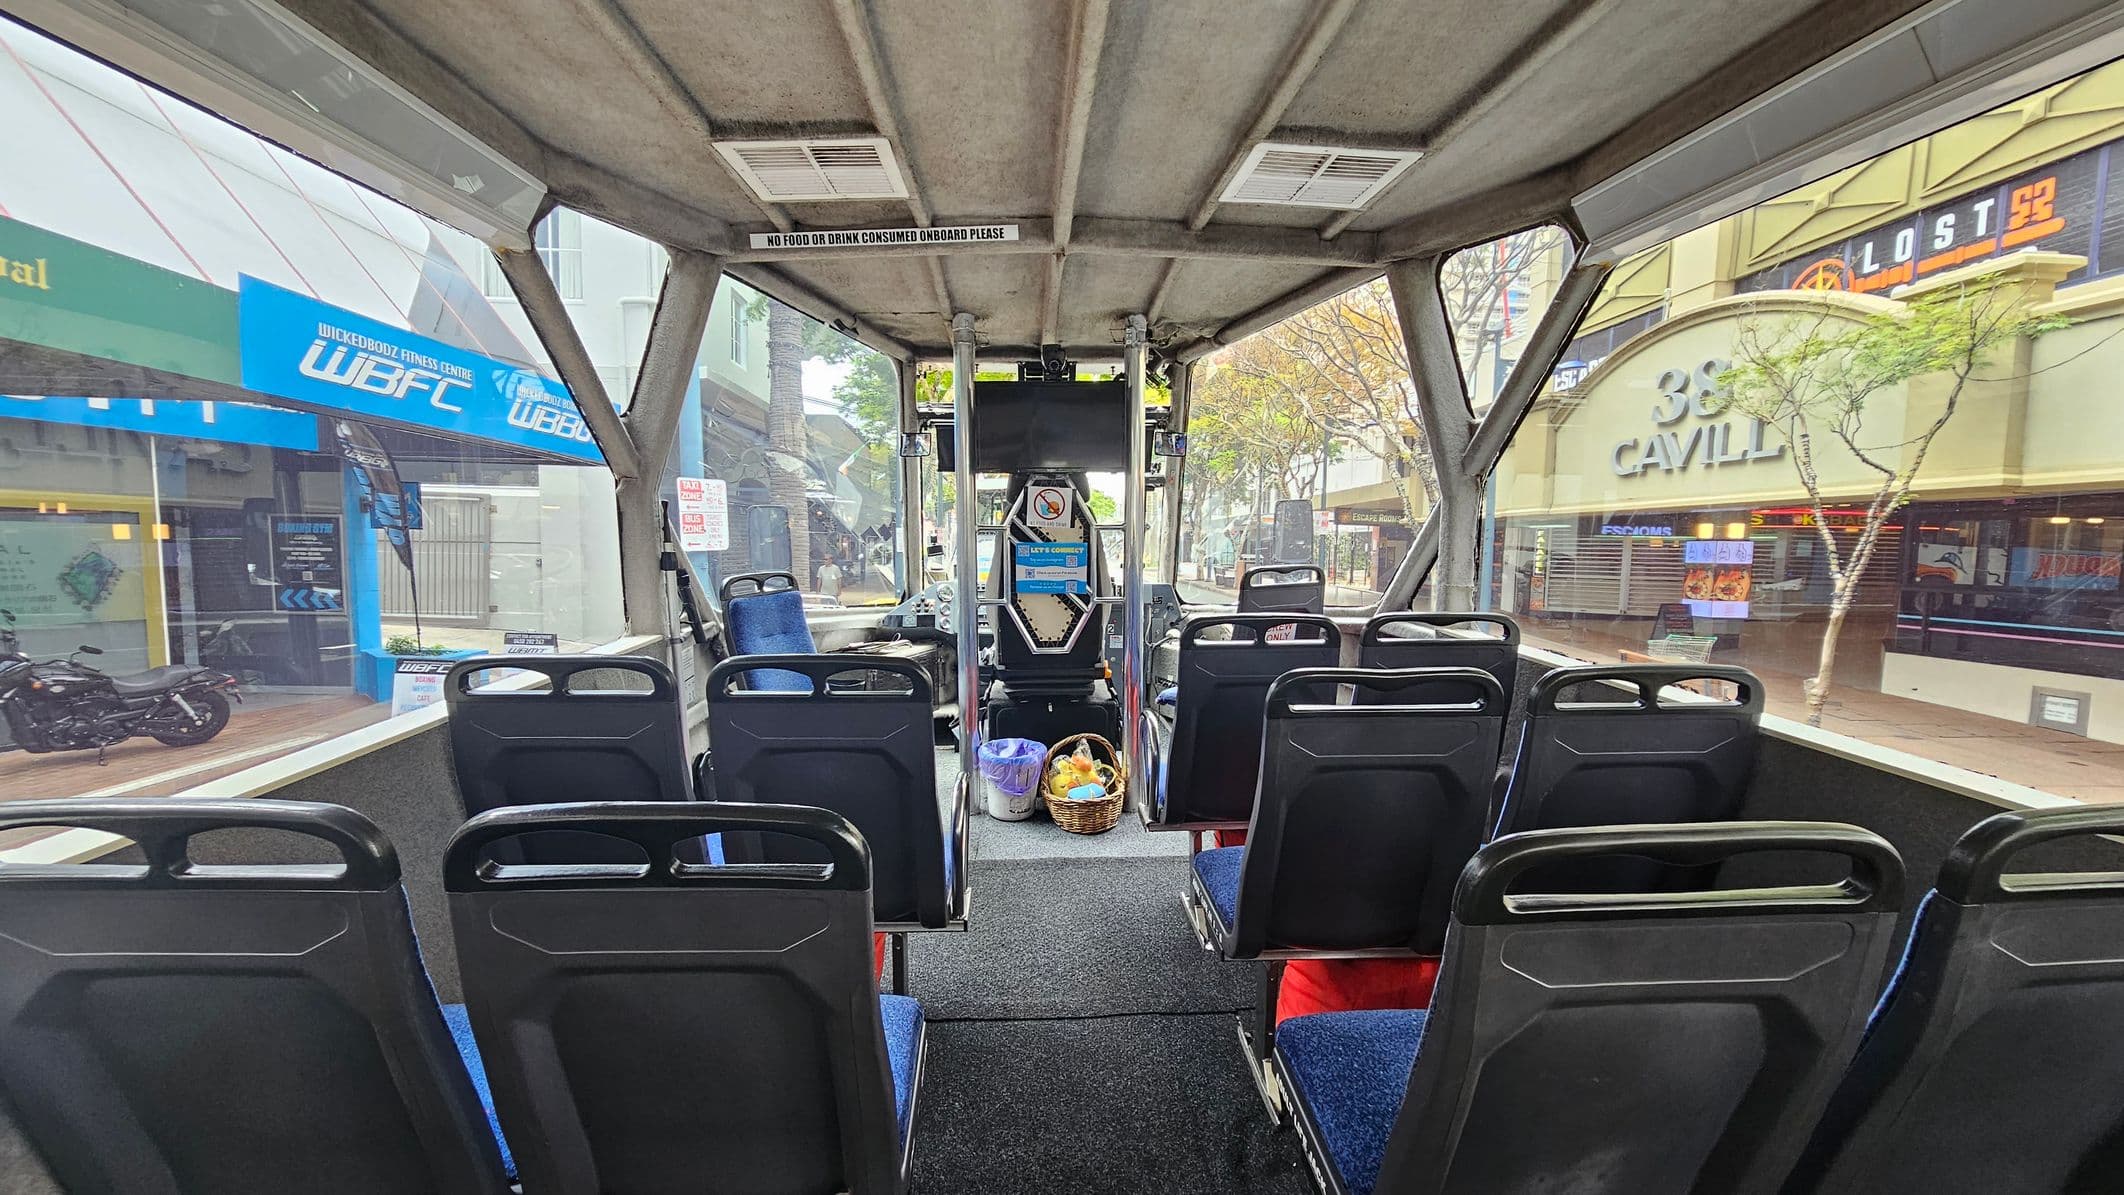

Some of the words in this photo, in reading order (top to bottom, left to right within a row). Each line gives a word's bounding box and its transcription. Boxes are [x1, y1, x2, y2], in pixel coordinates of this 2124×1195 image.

[767, 234, 781, 247] NO
[783, 233, 810, 247] FOOD
[811, 232, 827, 246] OR
[828, 231, 860, 245] DRINK
[861, 229, 918, 245] CONSUMED
[919, 228, 968, 242] ONBOARD
[969, 227, 1005, 240] PLEASE
[1863, 198, 1995, 273] LOST
[318, 322, 399, 359] WICKEDBODZ
[401, 348, 438, 371] FITNESS
[440, 361, 474, 382] CENTRE
[299, 338, 473, 413] WBFC
[1652, 358, 1733, 426] 38
[1612, 417, 1786, 478] CAVILL
[681, 492, 702, 501] ZONE
[1352, 513, 1377, 522] ESCAPE
[683, 525, 704, 534] ZONE
[1108, 625, 1114, 633] 2
[1266, 632, 1291, 641] ONLY
[398, 662, 453, 673] WBFC
